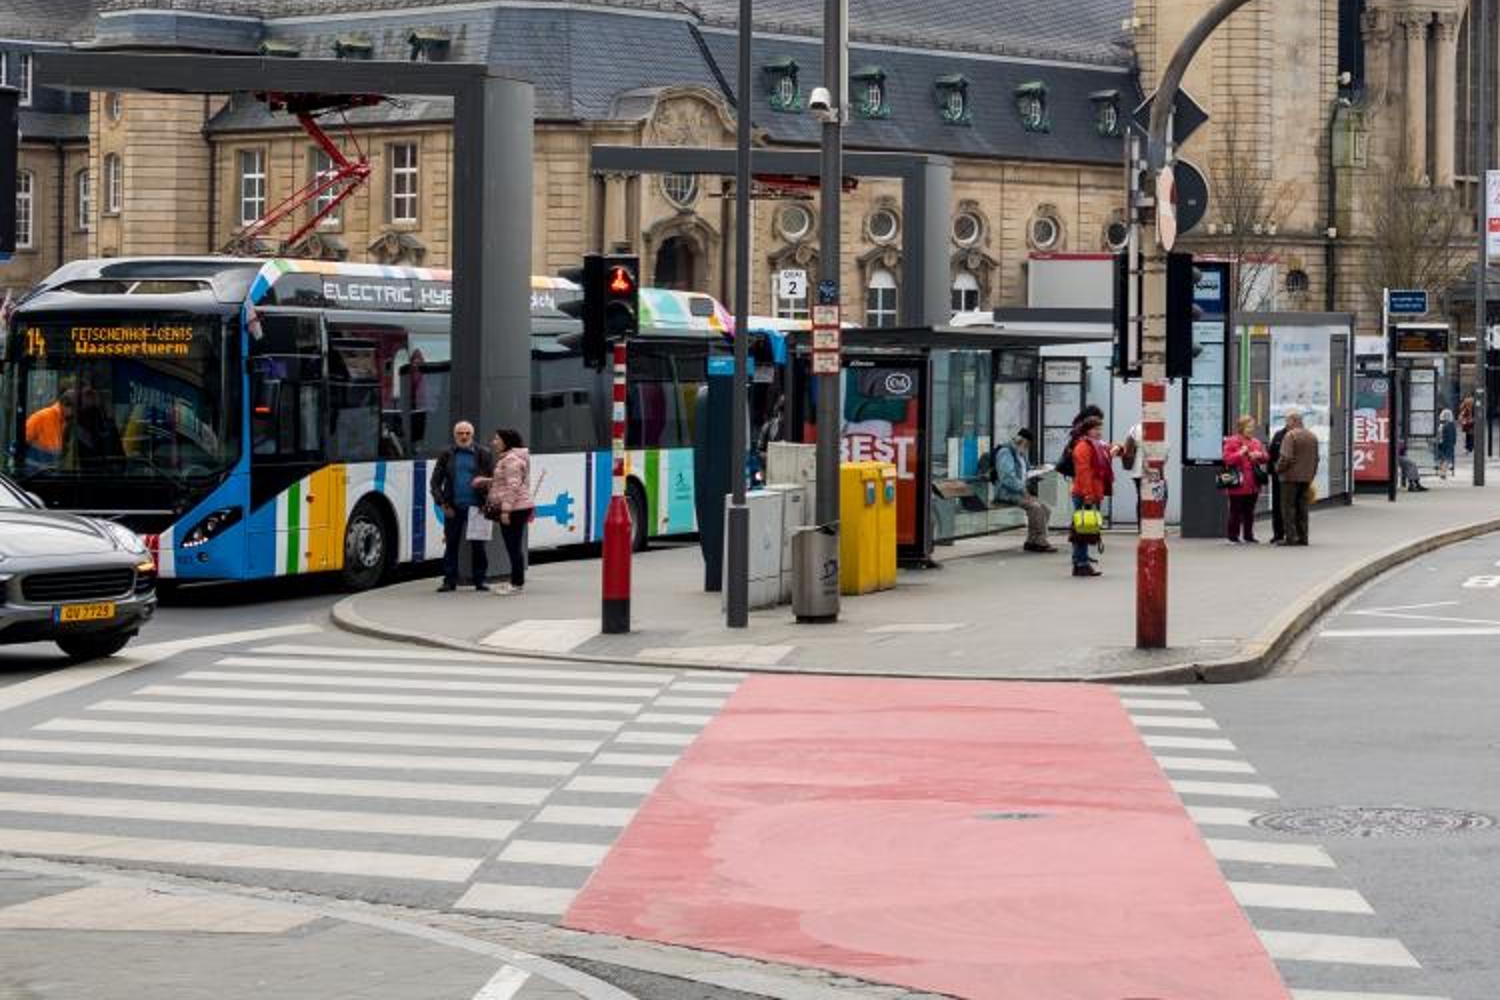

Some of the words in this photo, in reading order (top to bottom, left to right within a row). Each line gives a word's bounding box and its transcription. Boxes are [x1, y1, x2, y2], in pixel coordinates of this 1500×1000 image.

[323, 283, 412, 303] ELECTRIC
[788, 281, 797, 294] 2
[27, 328, 46, 356] 14
